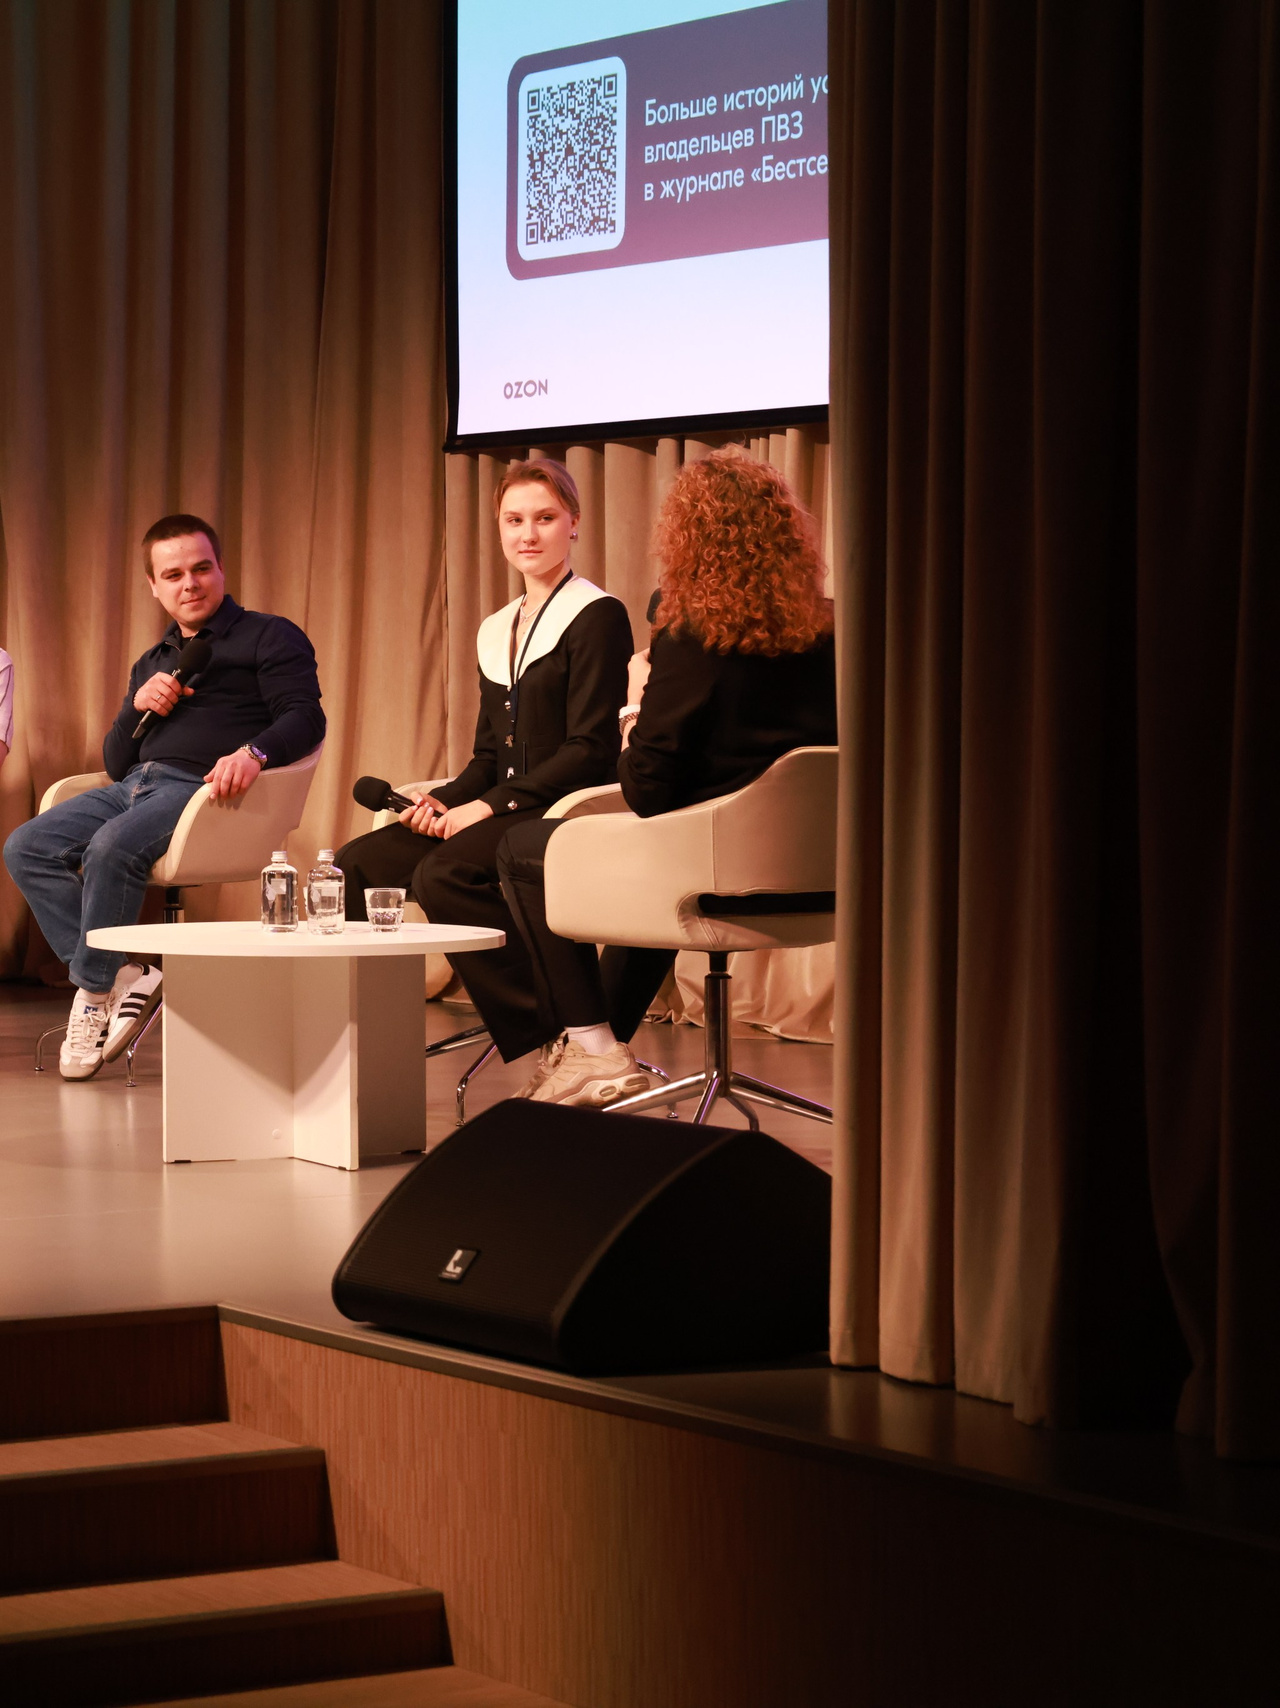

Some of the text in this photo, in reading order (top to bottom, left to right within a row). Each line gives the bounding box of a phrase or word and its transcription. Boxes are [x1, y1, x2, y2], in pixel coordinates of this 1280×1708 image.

[644, 95, 718, 126] Больше
[723, 73, 804, 112] историй
[644, 110, 804, 164] владельцев ПВЗ
[644, 182, 654, 201] в
[660, 167, 745, 203] журнале
[503, 378, 548, 400] OZON
